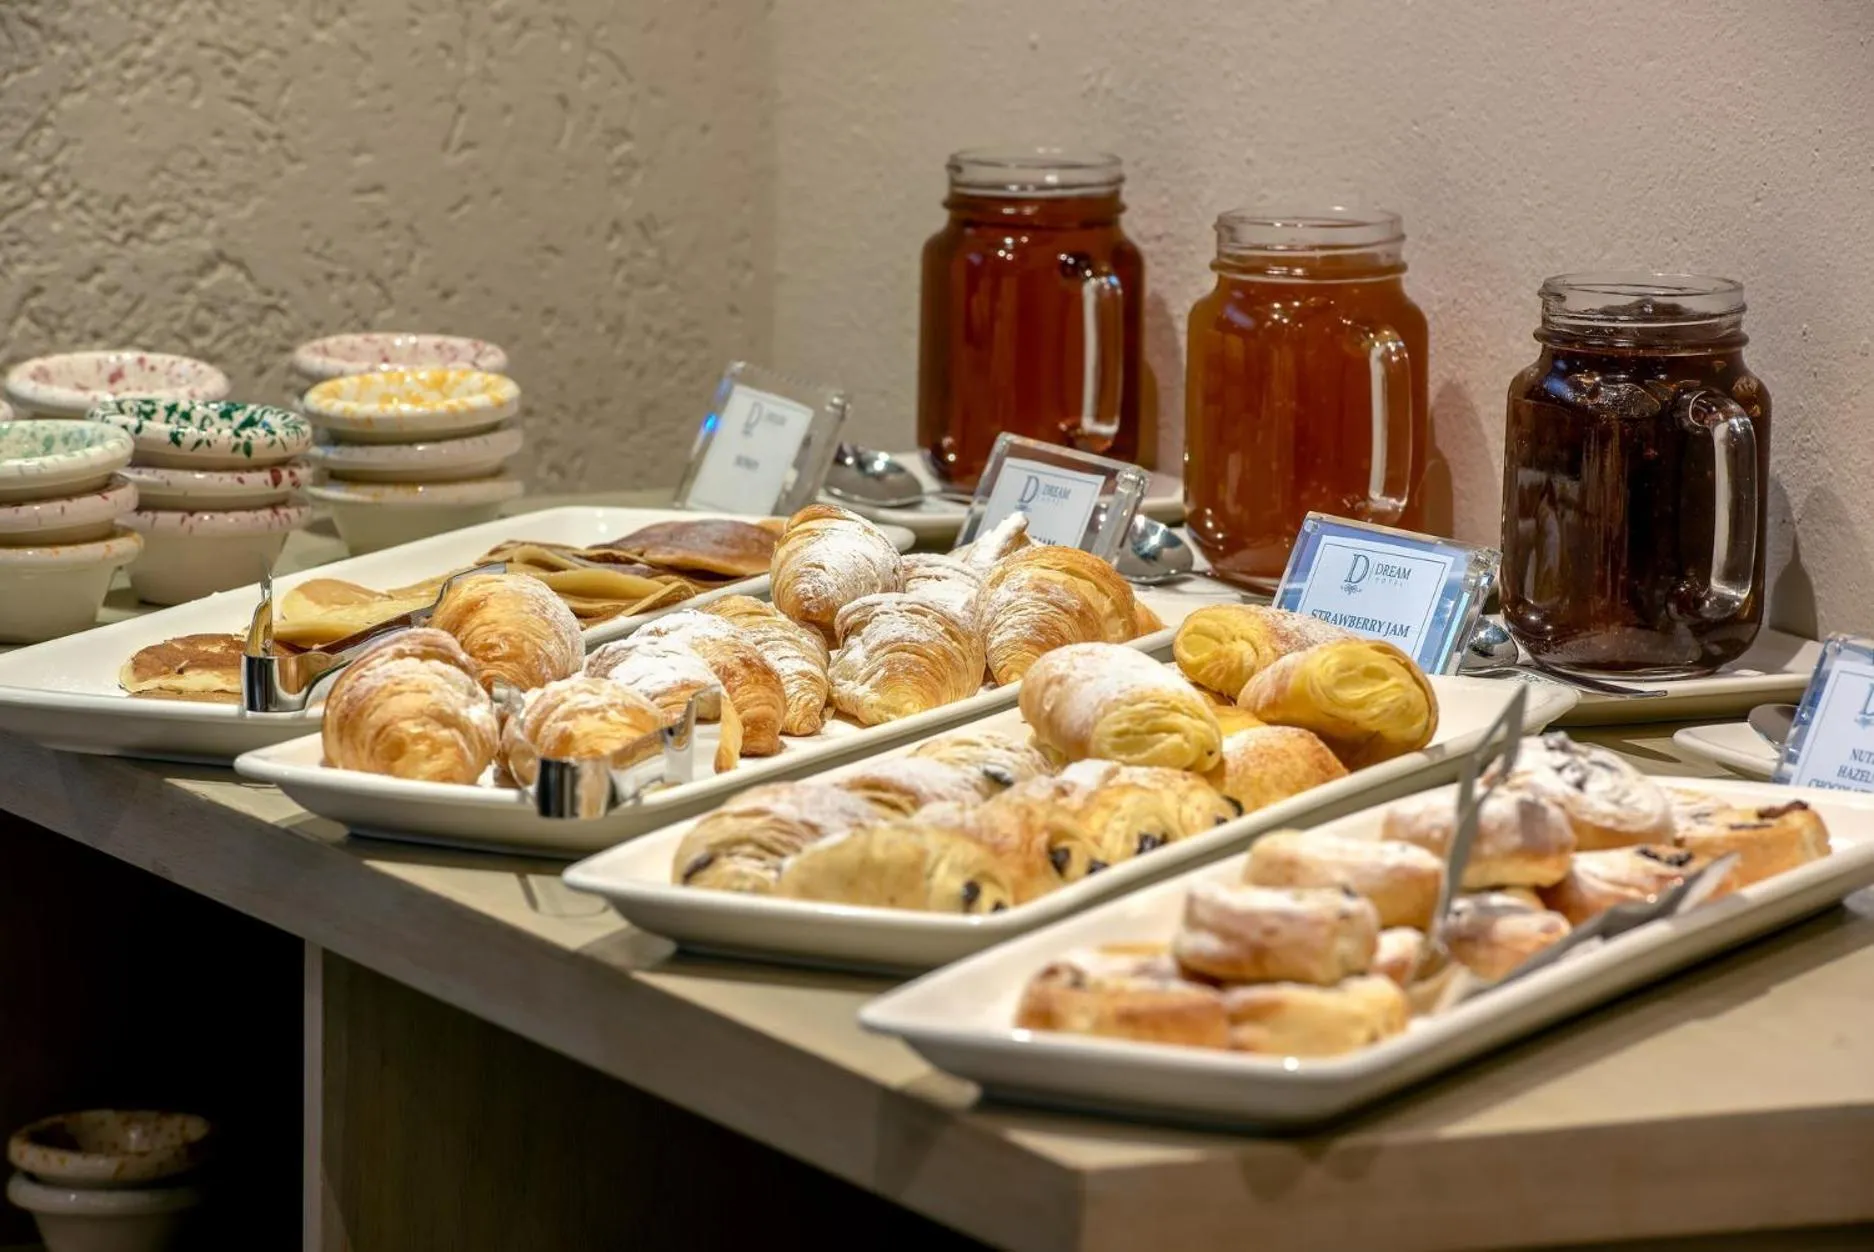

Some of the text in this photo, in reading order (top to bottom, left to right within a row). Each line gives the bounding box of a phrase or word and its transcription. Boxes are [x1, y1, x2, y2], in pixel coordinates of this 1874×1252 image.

[1017, 475, 1040, 503] D
[1344, 553, 1411, 584] D DREAM
[1311, 608, 1411, 638] STRAWBERRY JAM
[1850, 748, 1874, 765] NUT
[1837, 765, 1874, 783] HAZEL
